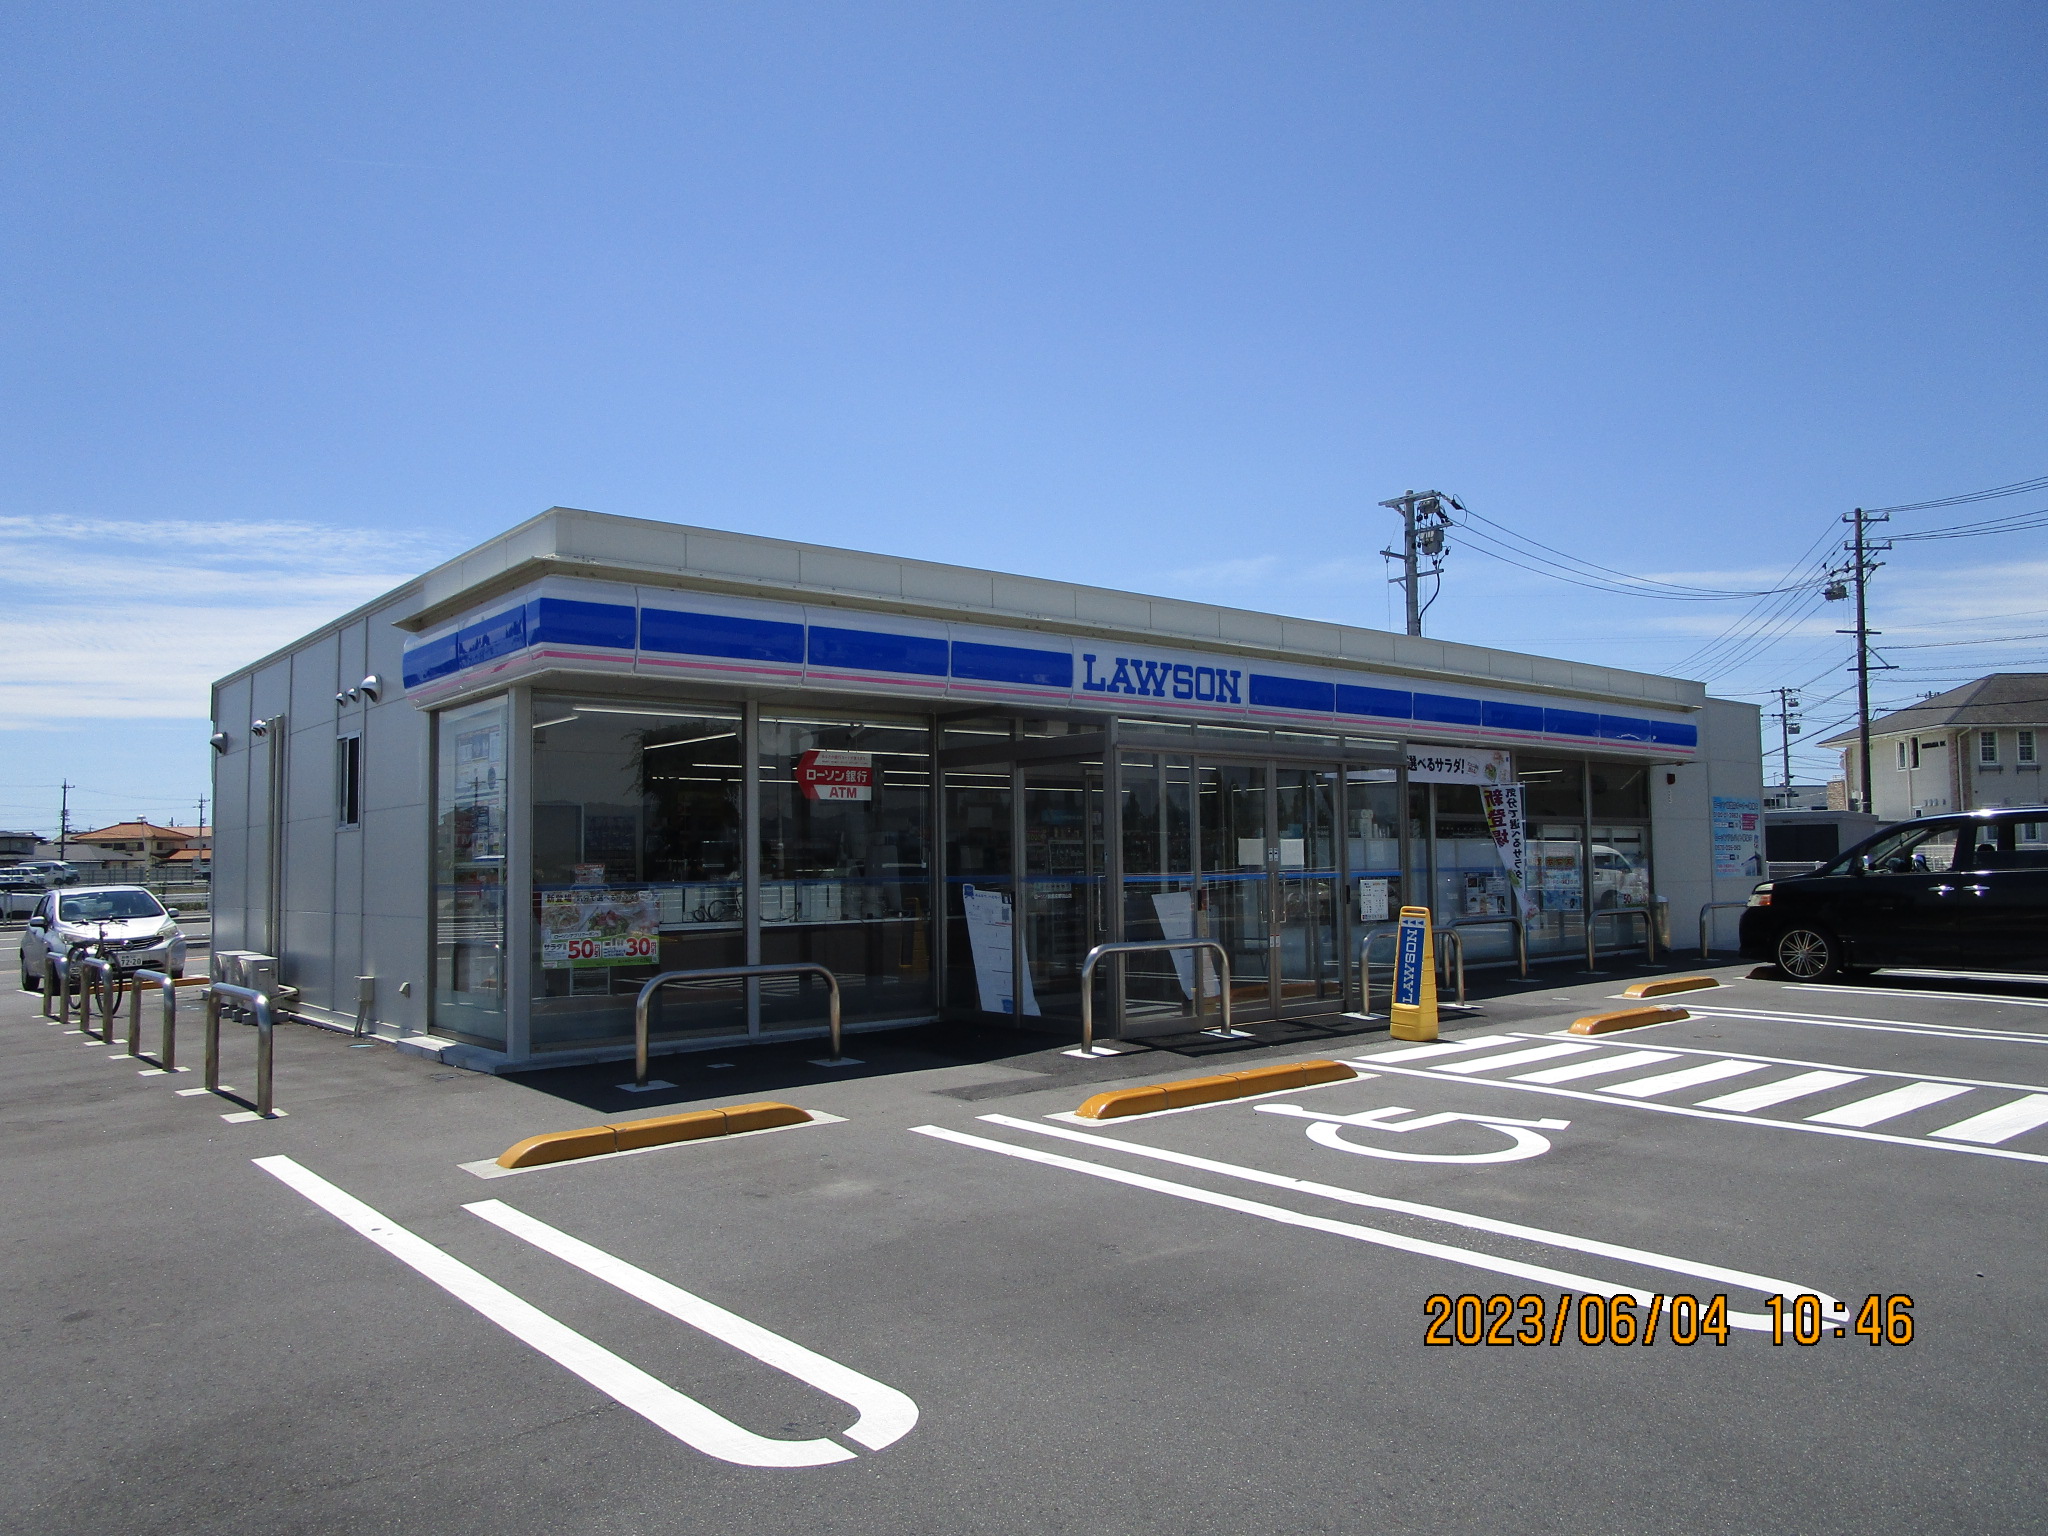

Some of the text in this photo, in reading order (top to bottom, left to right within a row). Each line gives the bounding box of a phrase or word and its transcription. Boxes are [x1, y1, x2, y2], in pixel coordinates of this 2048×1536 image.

[1083, 654, 1241, 704] LAWSON
[806, 769, 868, 783] ローソン銀行
[829, 787, 857, 798] ATM
[568, 940, 594, 959] 50
[625, 937, 651, 957] 30
[1402, 929, 1418, 1004] LAWSON
